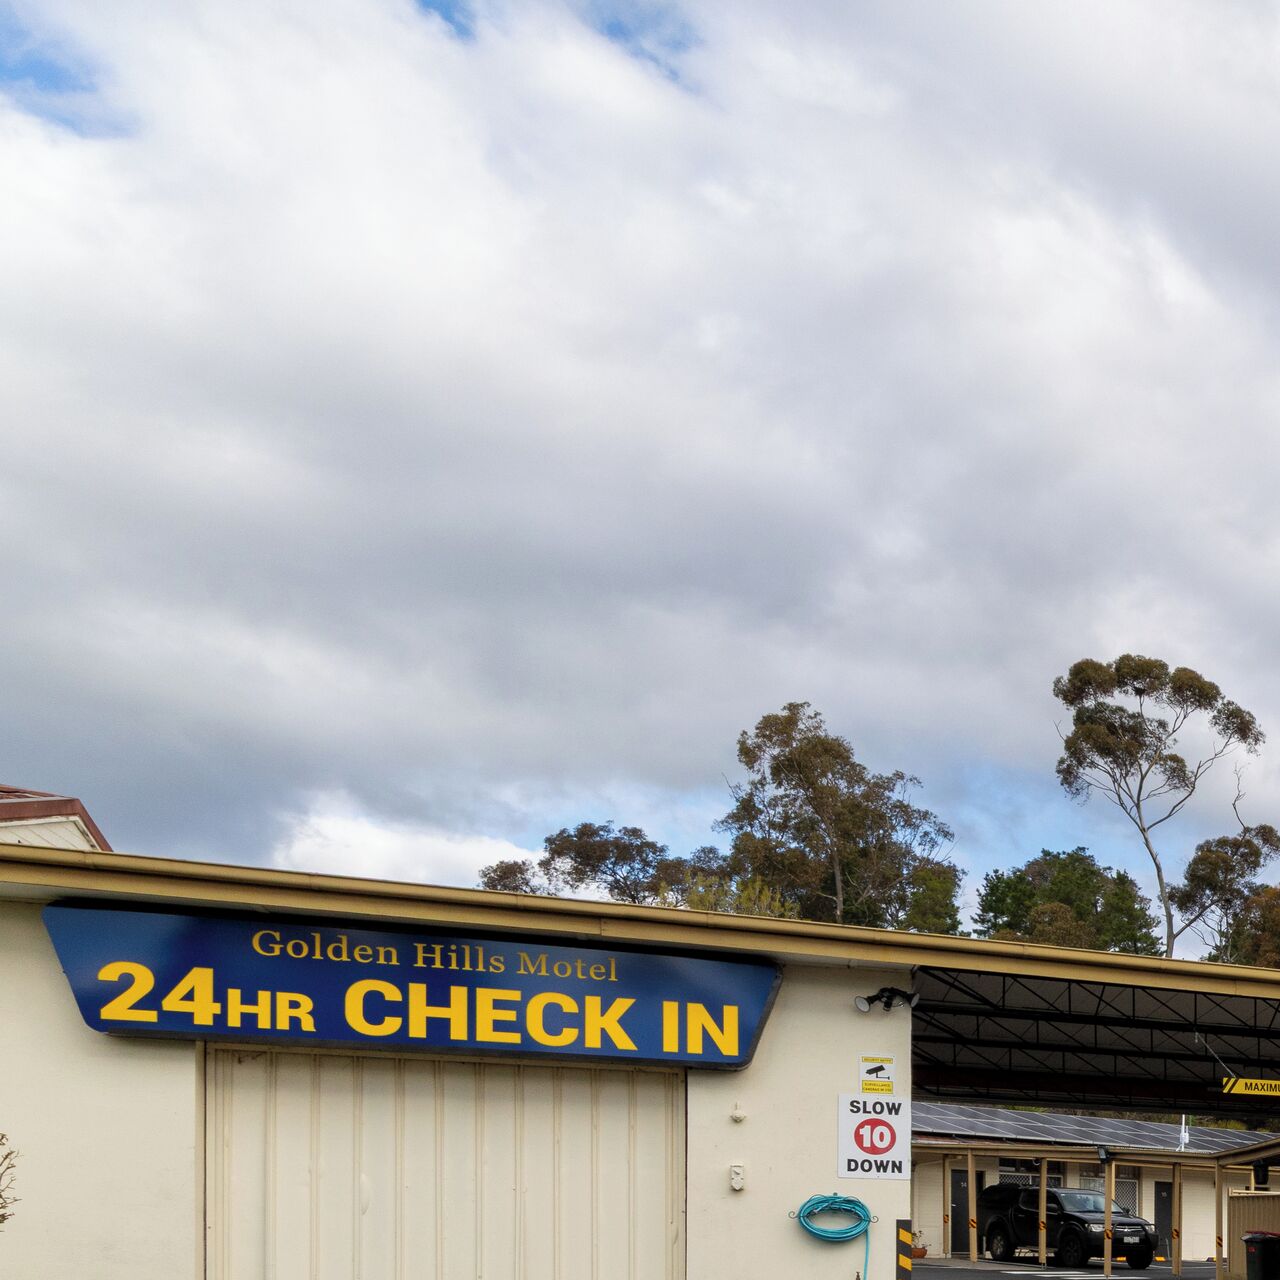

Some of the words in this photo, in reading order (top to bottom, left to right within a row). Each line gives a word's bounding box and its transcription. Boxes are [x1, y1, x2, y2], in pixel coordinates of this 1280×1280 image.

[252, 929, 400, 966] Golden
[413, 943, 505, 973] Hills
[516, 952, 619, 982] Motel
[344, 979, 639, 1051] CHECK
[662, 1001, 739, 1057] IN
[849, 1100, 902, 1115] SLOW
[859, 1125, 892, 1149] 10
[847, 1159, 903, 1174] DOWN
